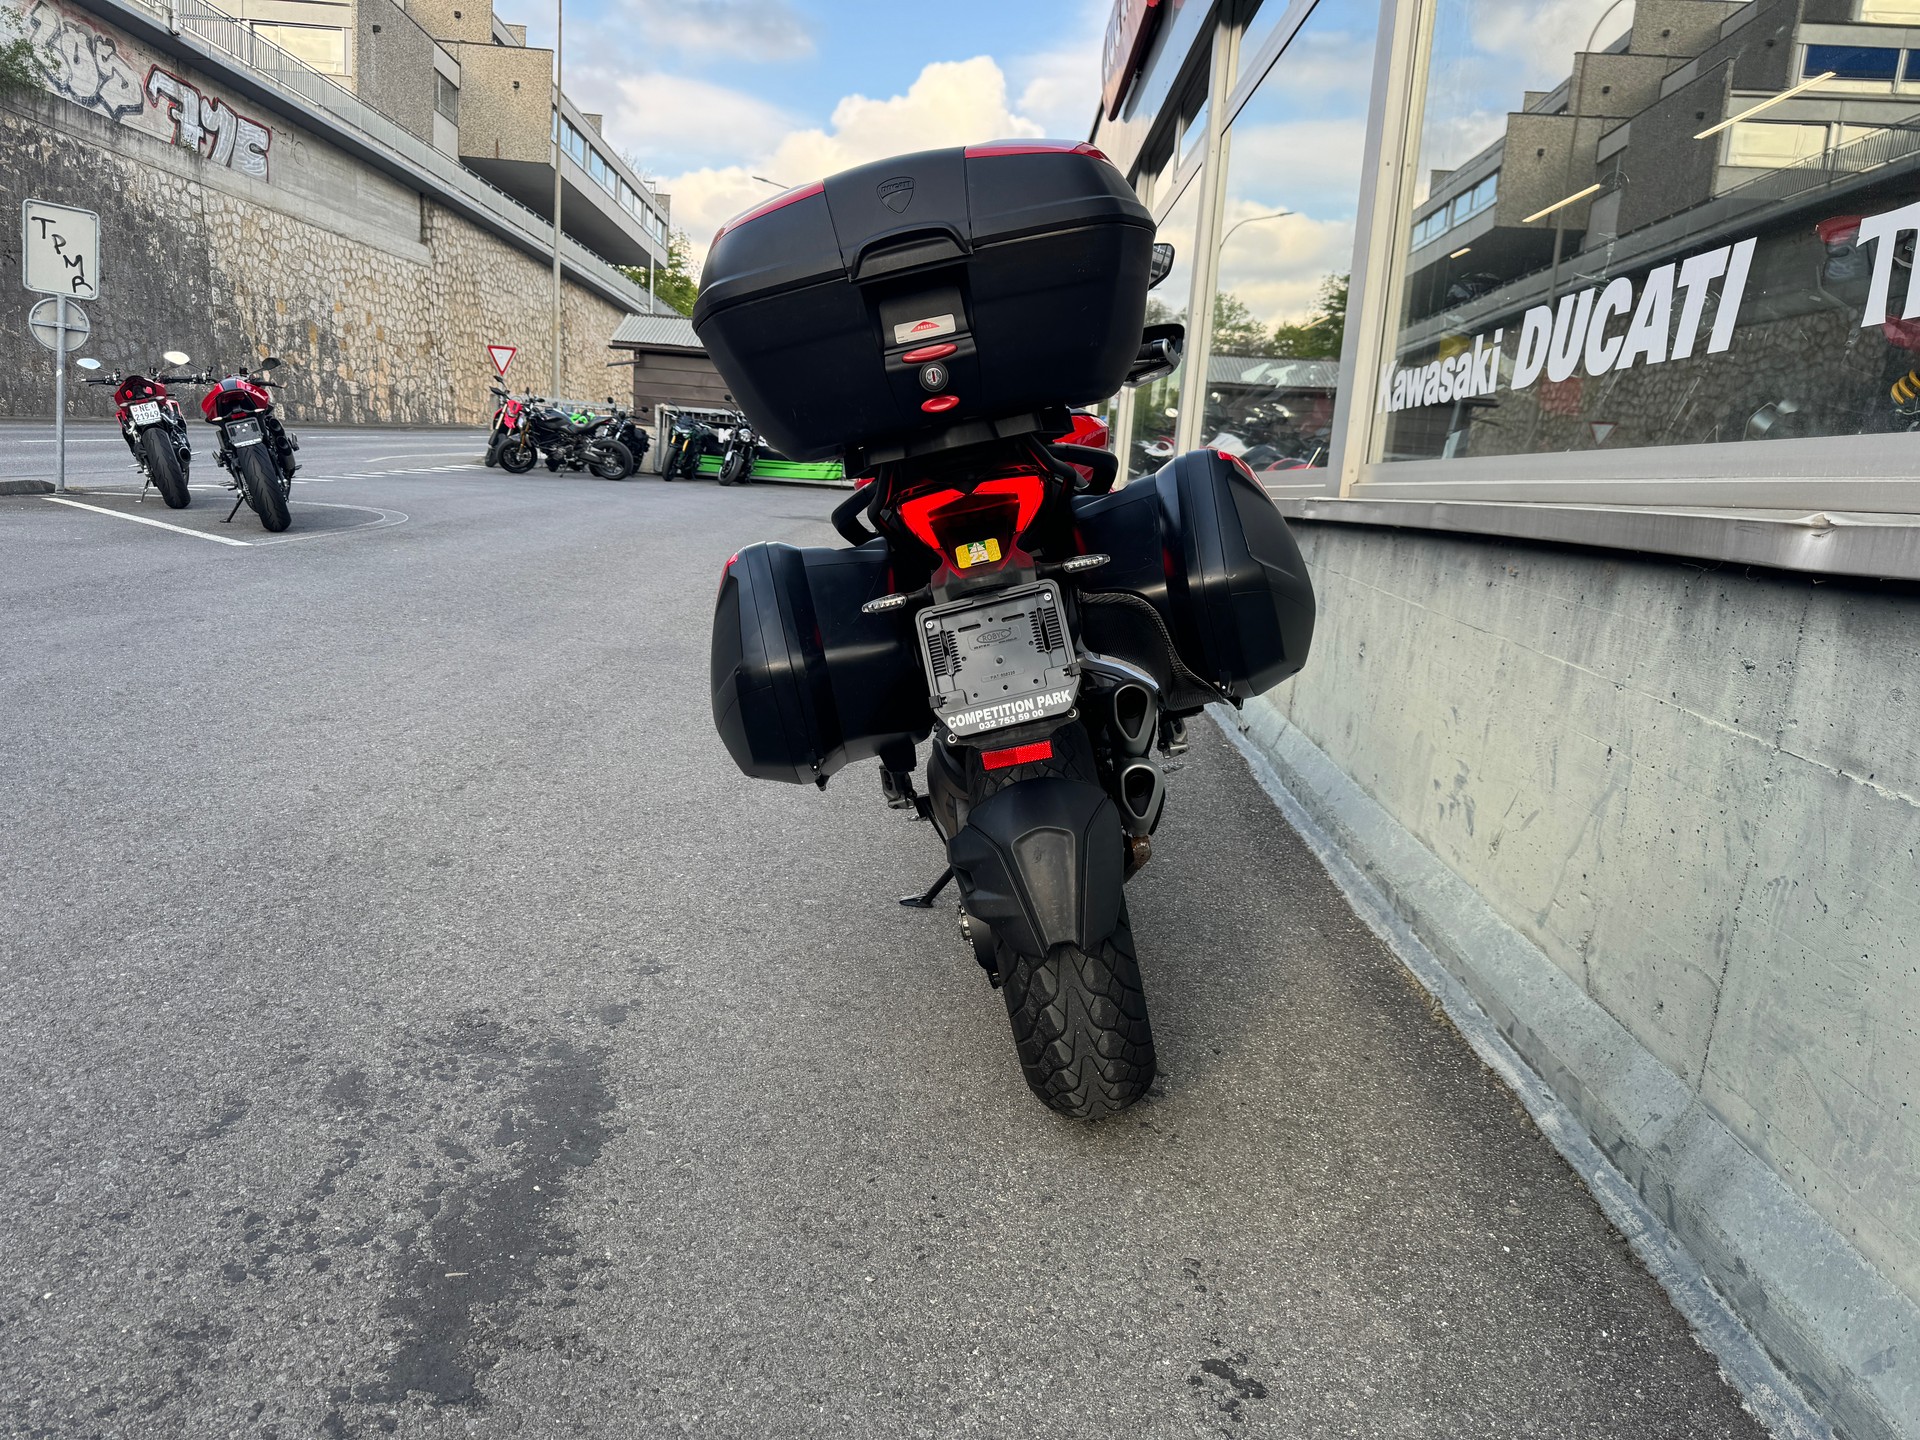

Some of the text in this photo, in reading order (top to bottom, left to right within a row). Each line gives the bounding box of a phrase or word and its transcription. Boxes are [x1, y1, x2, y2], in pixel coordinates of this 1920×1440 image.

[31, 216, 93, 293] TPMR
[1377, 329, 1503, 414] Kawasaki
[1510, 237, 1758, 391] DUCATI
[135, 410, 159, 421] 21949
[138, 403, 151, 412] NE
[982, 630, 1007, 641] ROBYC
[947, 689, 1072, 729] COMPETITION PARK
[978, 709, 1044, 730] 032 753 59 00
